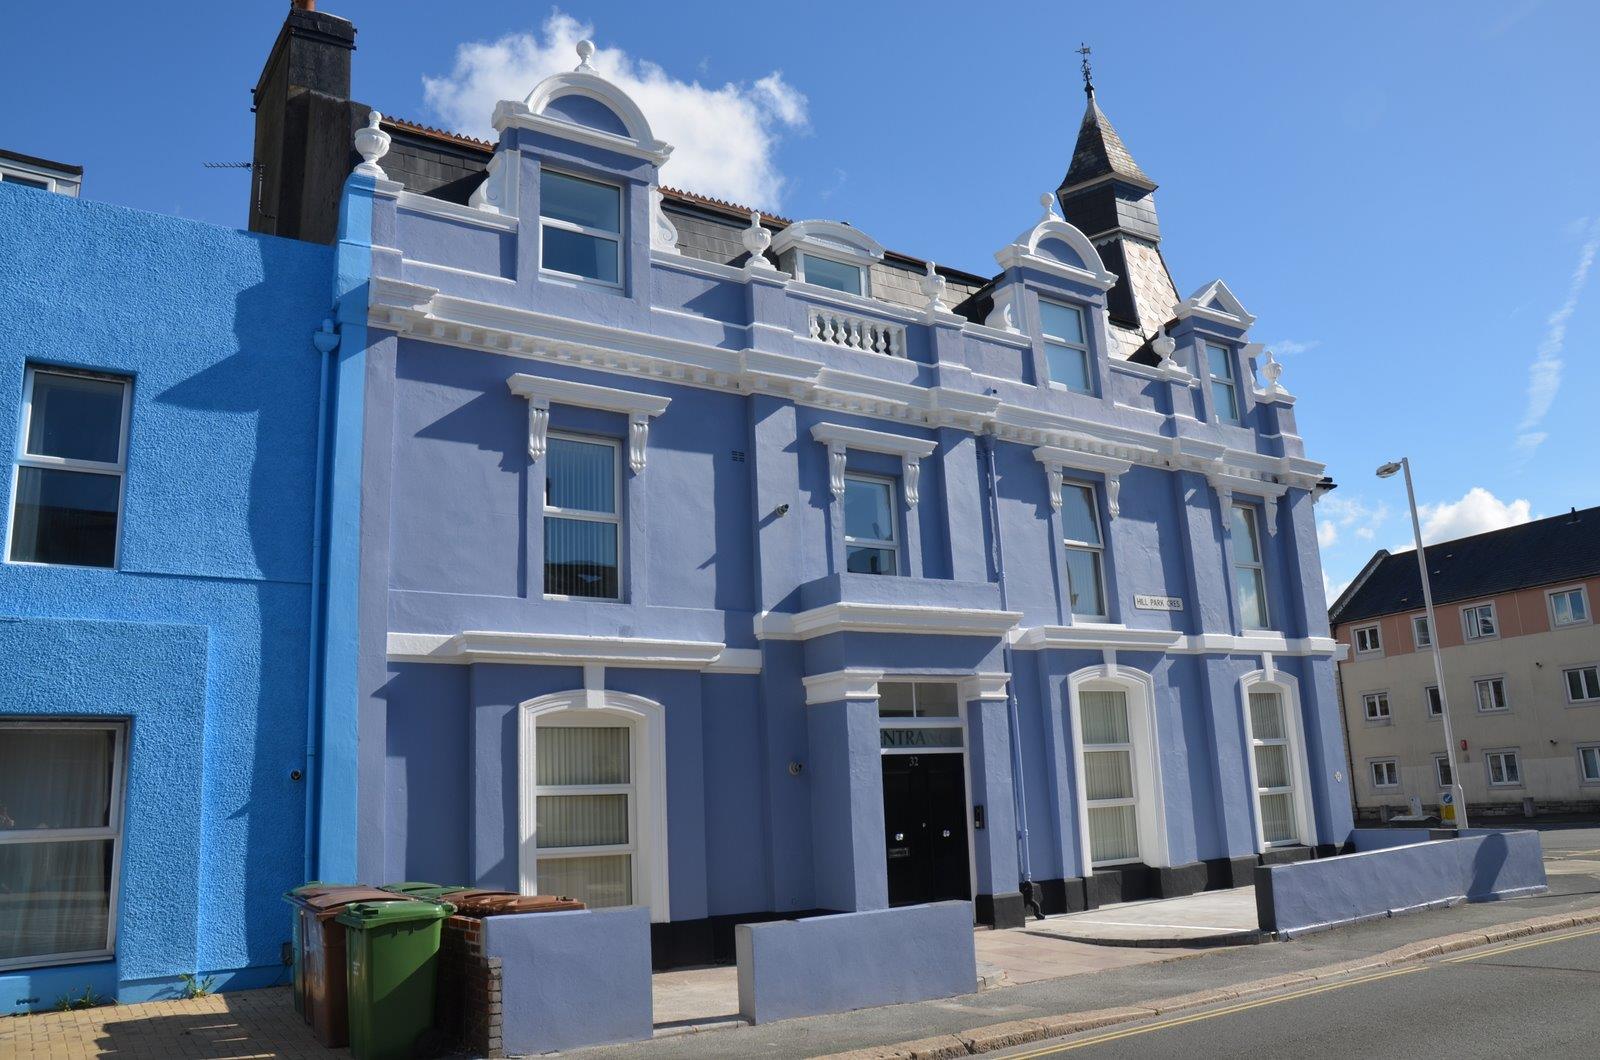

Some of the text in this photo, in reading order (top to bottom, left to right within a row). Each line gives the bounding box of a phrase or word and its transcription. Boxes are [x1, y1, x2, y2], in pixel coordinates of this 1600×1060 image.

[1136, 597, 1181, 608] HILL PARK CRES
[880, 729, 957, 746] NTRANCE
[909, 756, 919, 768] 32
